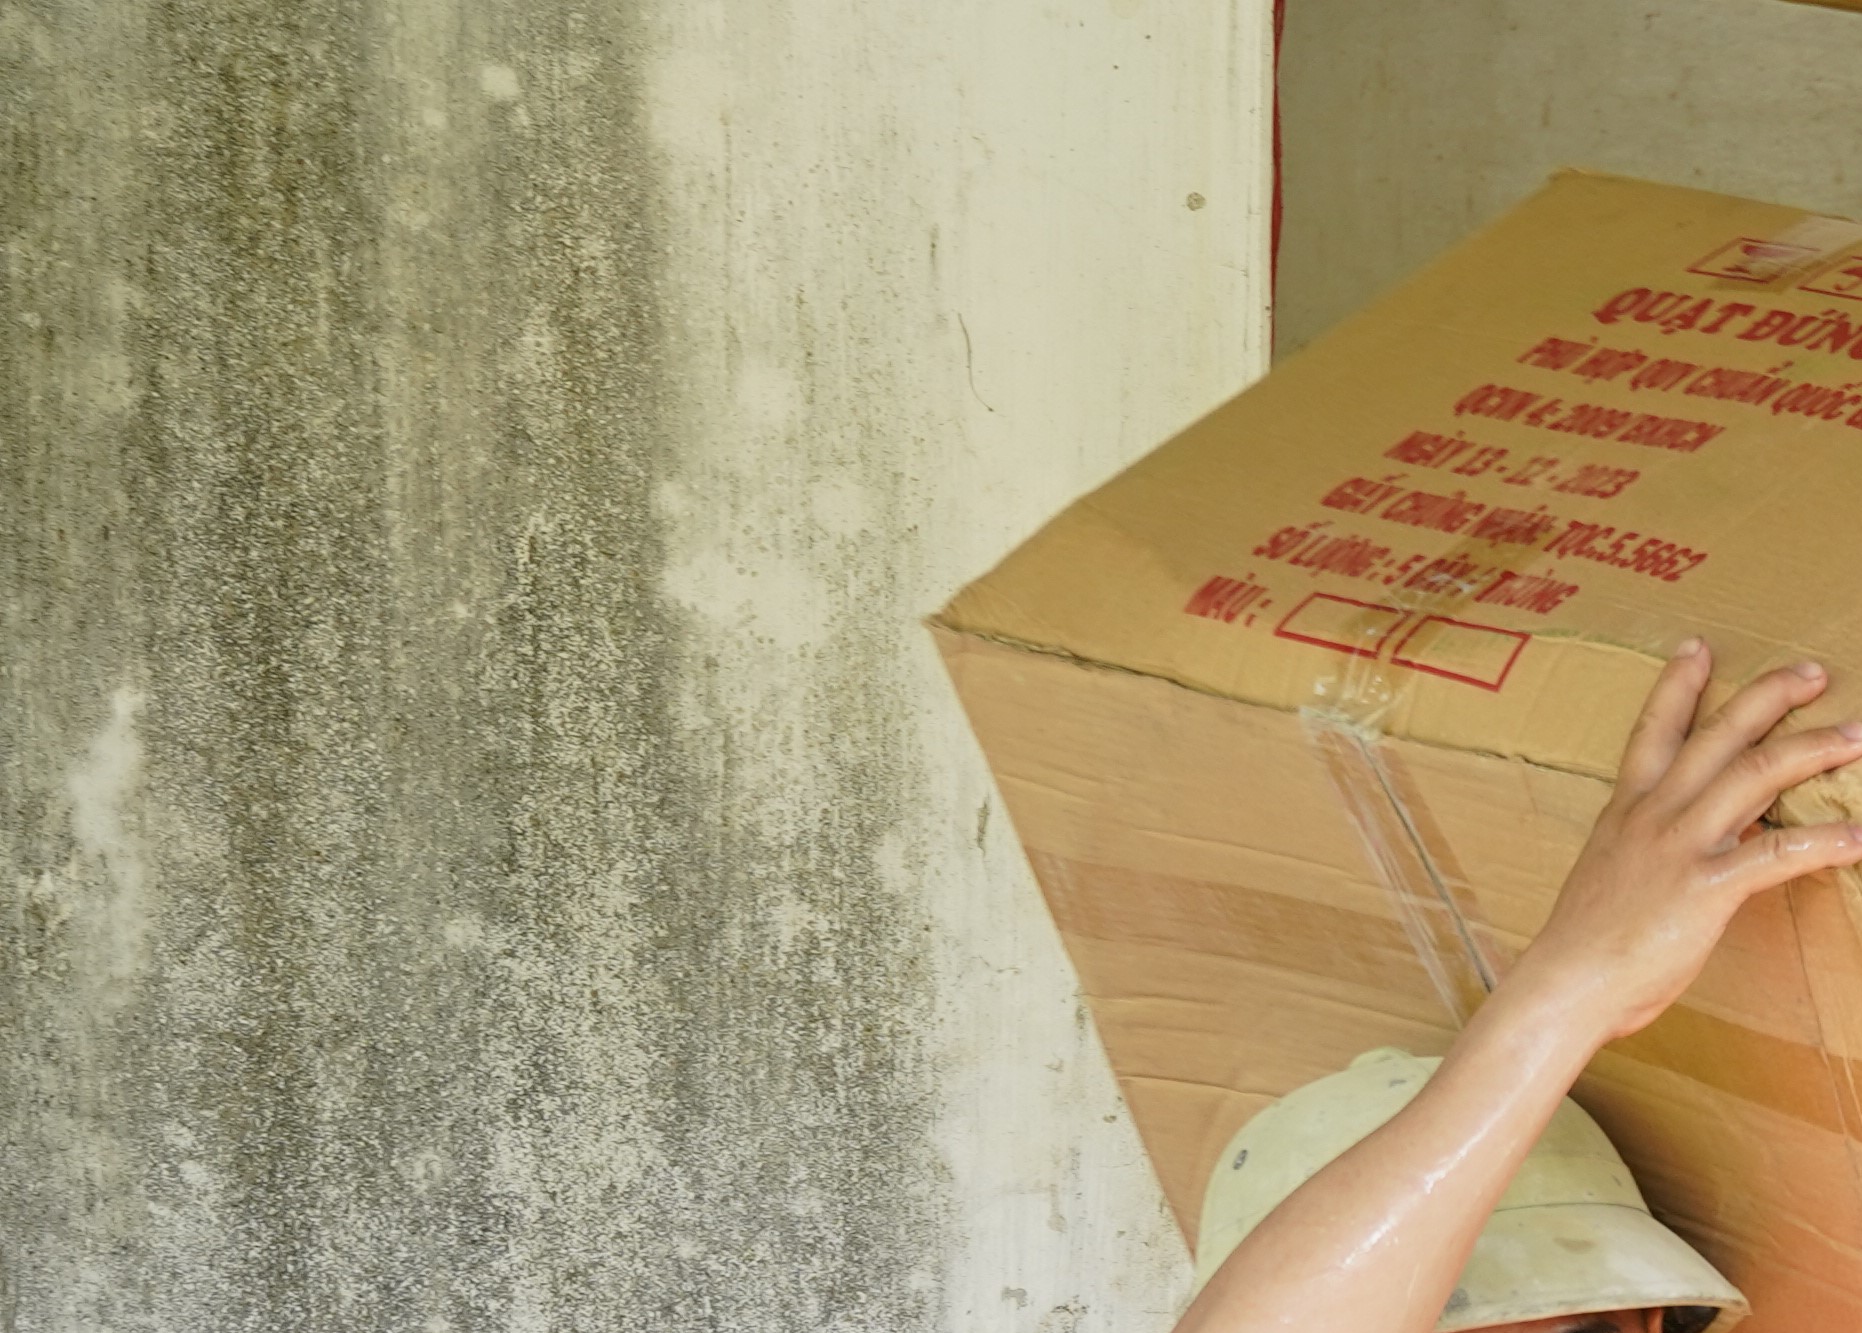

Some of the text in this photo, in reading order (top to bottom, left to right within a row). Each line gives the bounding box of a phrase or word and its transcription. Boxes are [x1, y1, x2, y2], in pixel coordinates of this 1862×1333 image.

[1595, 288, 1754, 335] QUẠT
[1454, 448, 1507, 476] 13
[1503, 457, 1558, 485] 12
